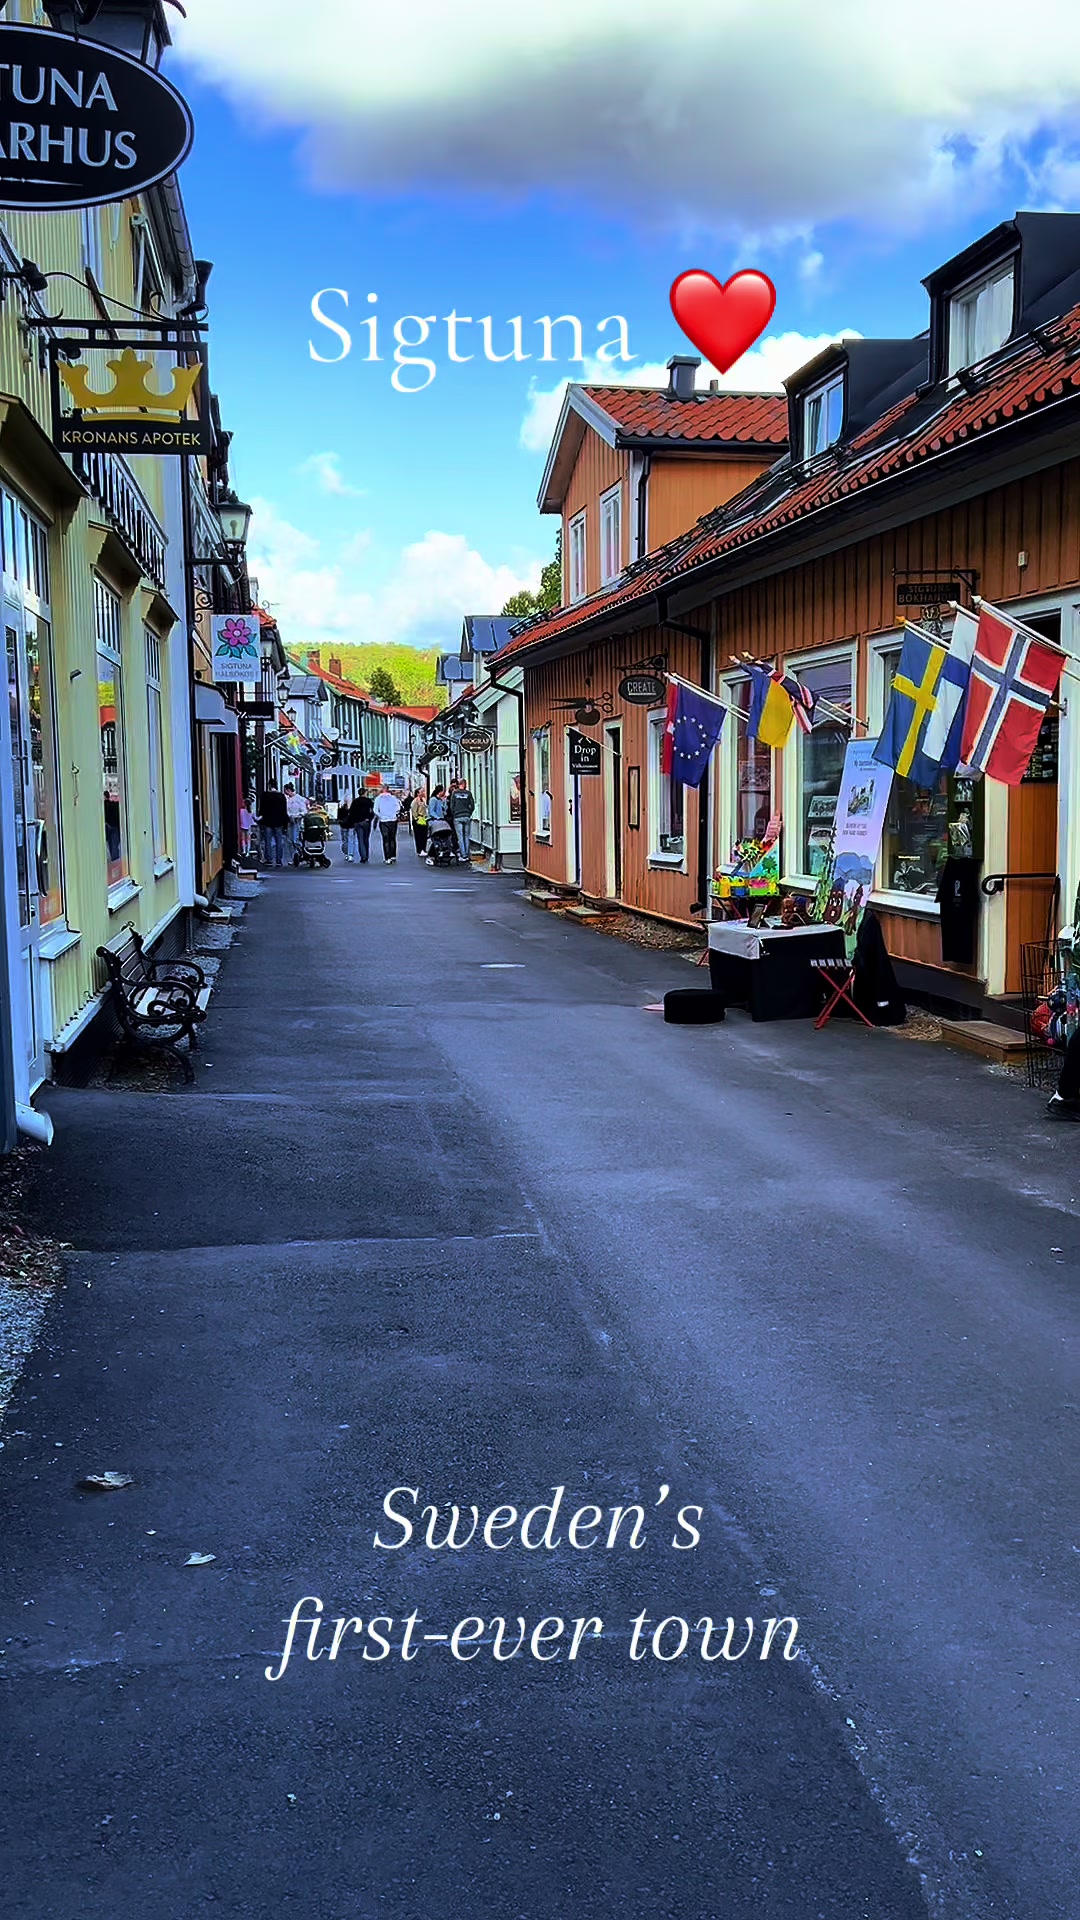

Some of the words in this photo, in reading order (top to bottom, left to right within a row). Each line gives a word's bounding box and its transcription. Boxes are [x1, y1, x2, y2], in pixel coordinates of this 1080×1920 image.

[0, 121, 138, 170] RHUS
[61, 430, 138, 445] KRONANS
[141, 432, 201, 446] APOTEK
[627, 681, 656, 693] CREATE
[574, 744, 597, 756] Drop
[580, 753, 590, 762] in
